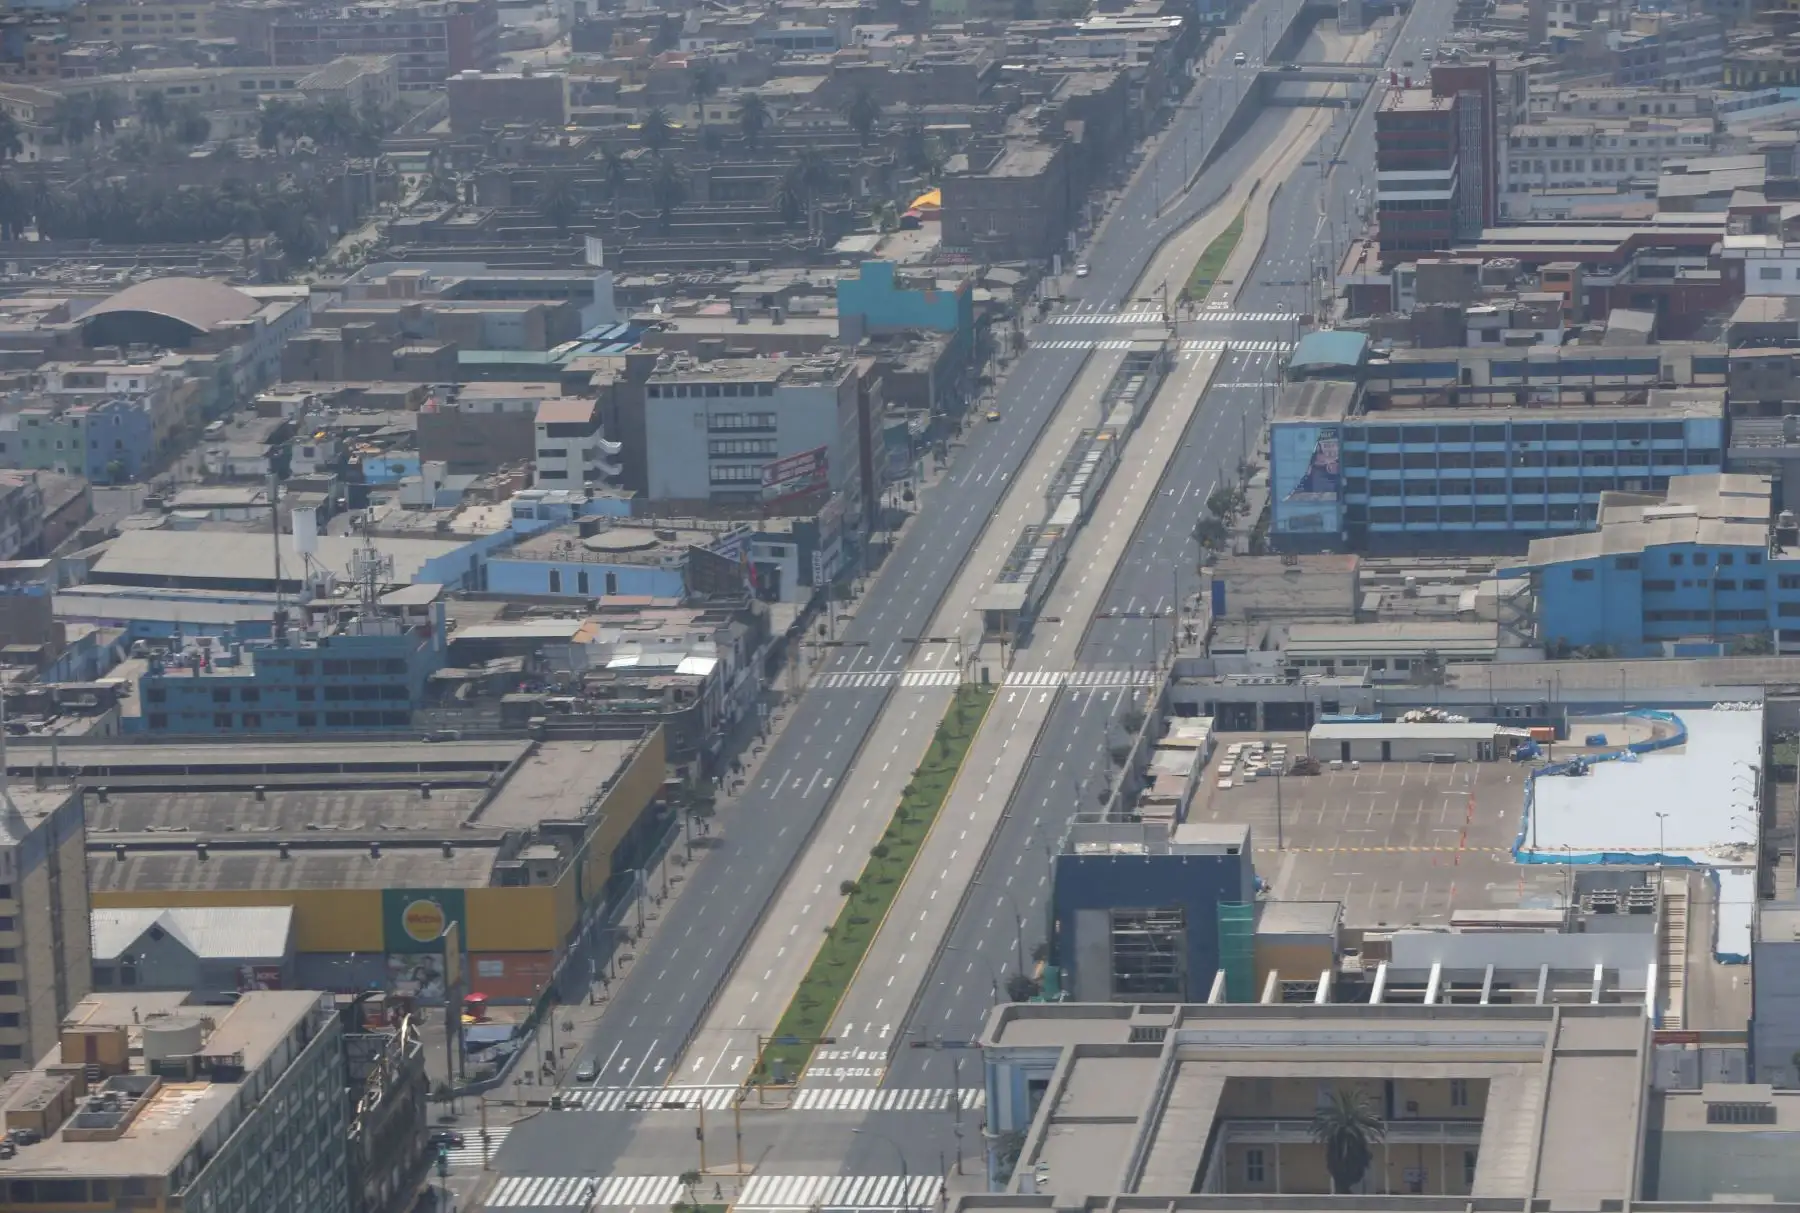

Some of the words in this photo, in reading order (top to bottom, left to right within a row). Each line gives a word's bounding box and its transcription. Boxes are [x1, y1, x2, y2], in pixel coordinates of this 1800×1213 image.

[816, 1050, 851, 1060] BUS
[856, 1051, 888, 1060] BUS
[806, 1067, 844, 1077] SOLO
[846, 1067, 883, 1077] SOLO
